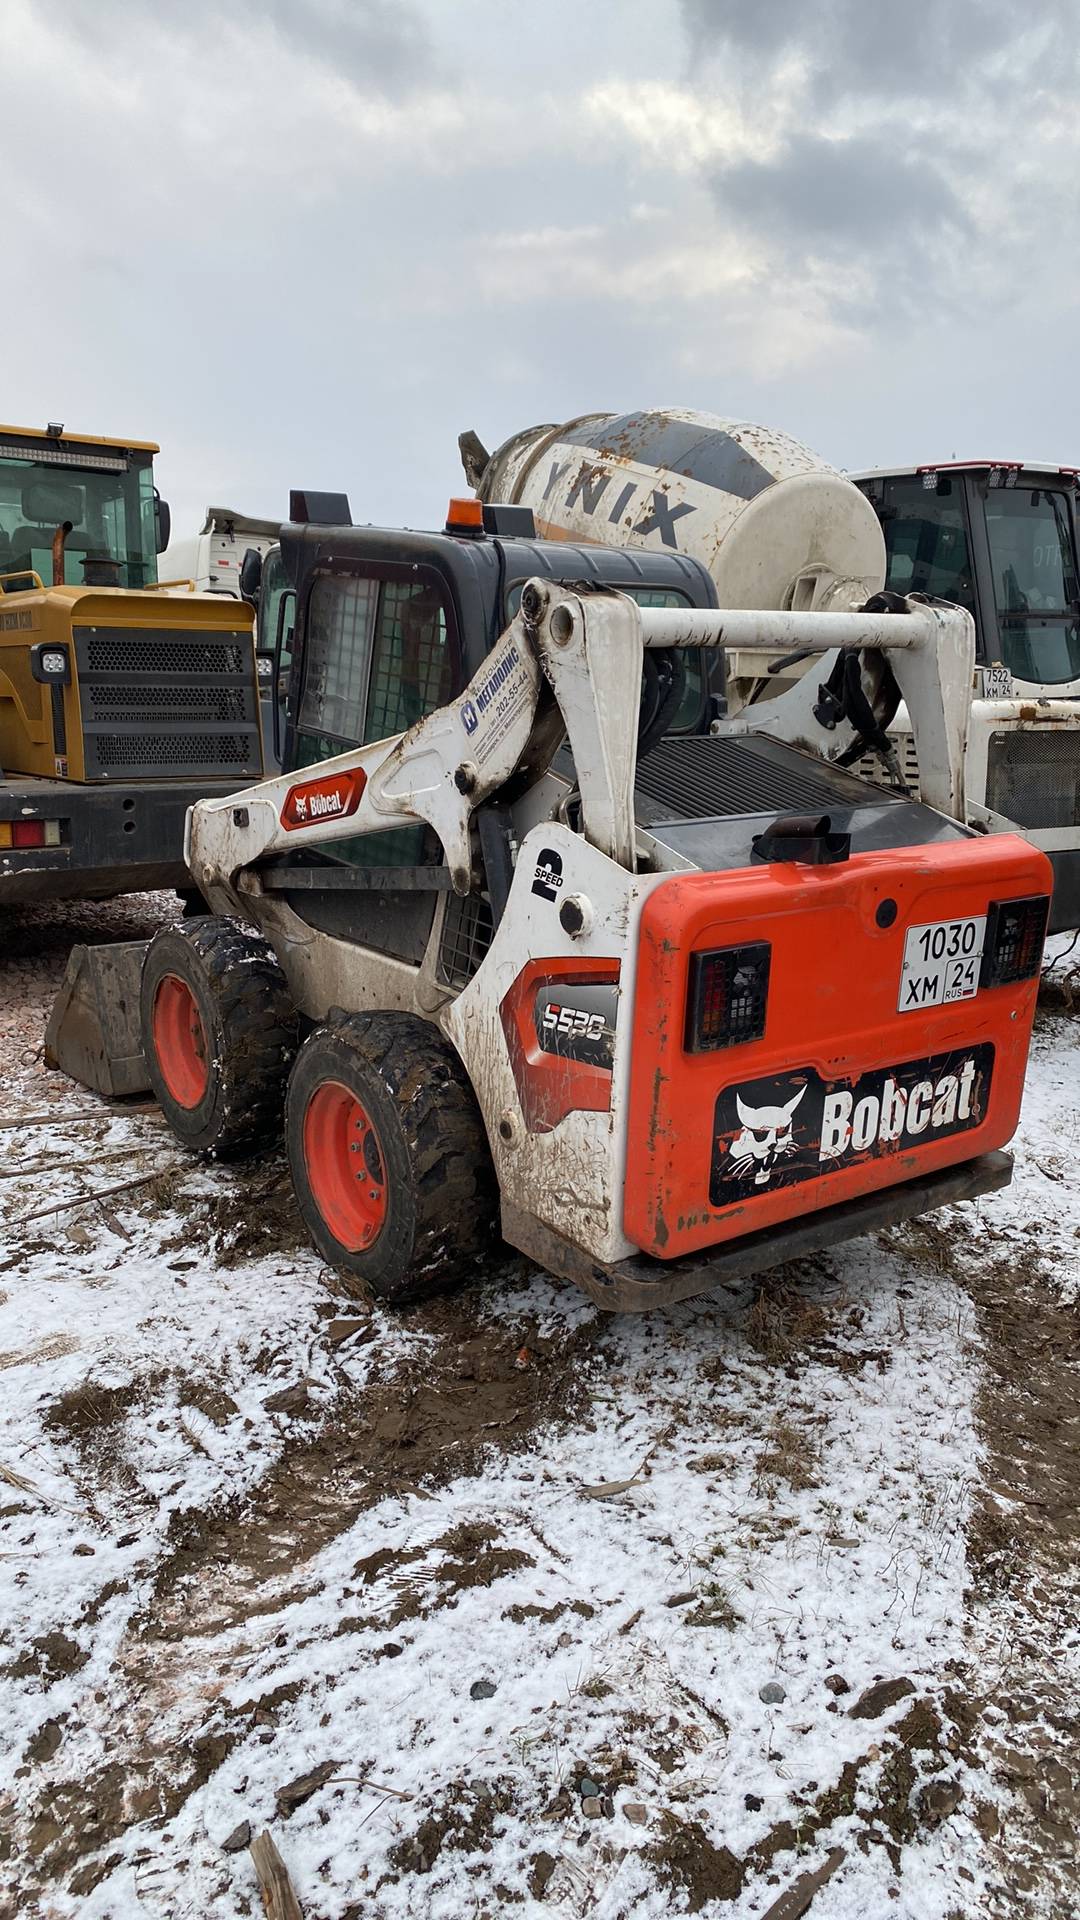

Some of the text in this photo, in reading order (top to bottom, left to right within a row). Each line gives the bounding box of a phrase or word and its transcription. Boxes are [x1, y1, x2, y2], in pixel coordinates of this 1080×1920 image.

[476, 646, 519, 713] МЕГАПОЛИС
[986, 669, 1008, 683] 7522
[1002, 685, 1011, 695] 24
[495, 670, 529, 717] 202-55-44
[310, 789, 342, 816] Bobcat
[531, 847, 563, 903] 2
[533, 866, 564, 888] SPEED
[918, 921, 976, 962] 1030
[951, 959, 975, 988] 24
[945, 988, 963, 999] RUS
[542, 1003, 606, 1041] S530
[818, 1059, 976, 1162] Bobcat
